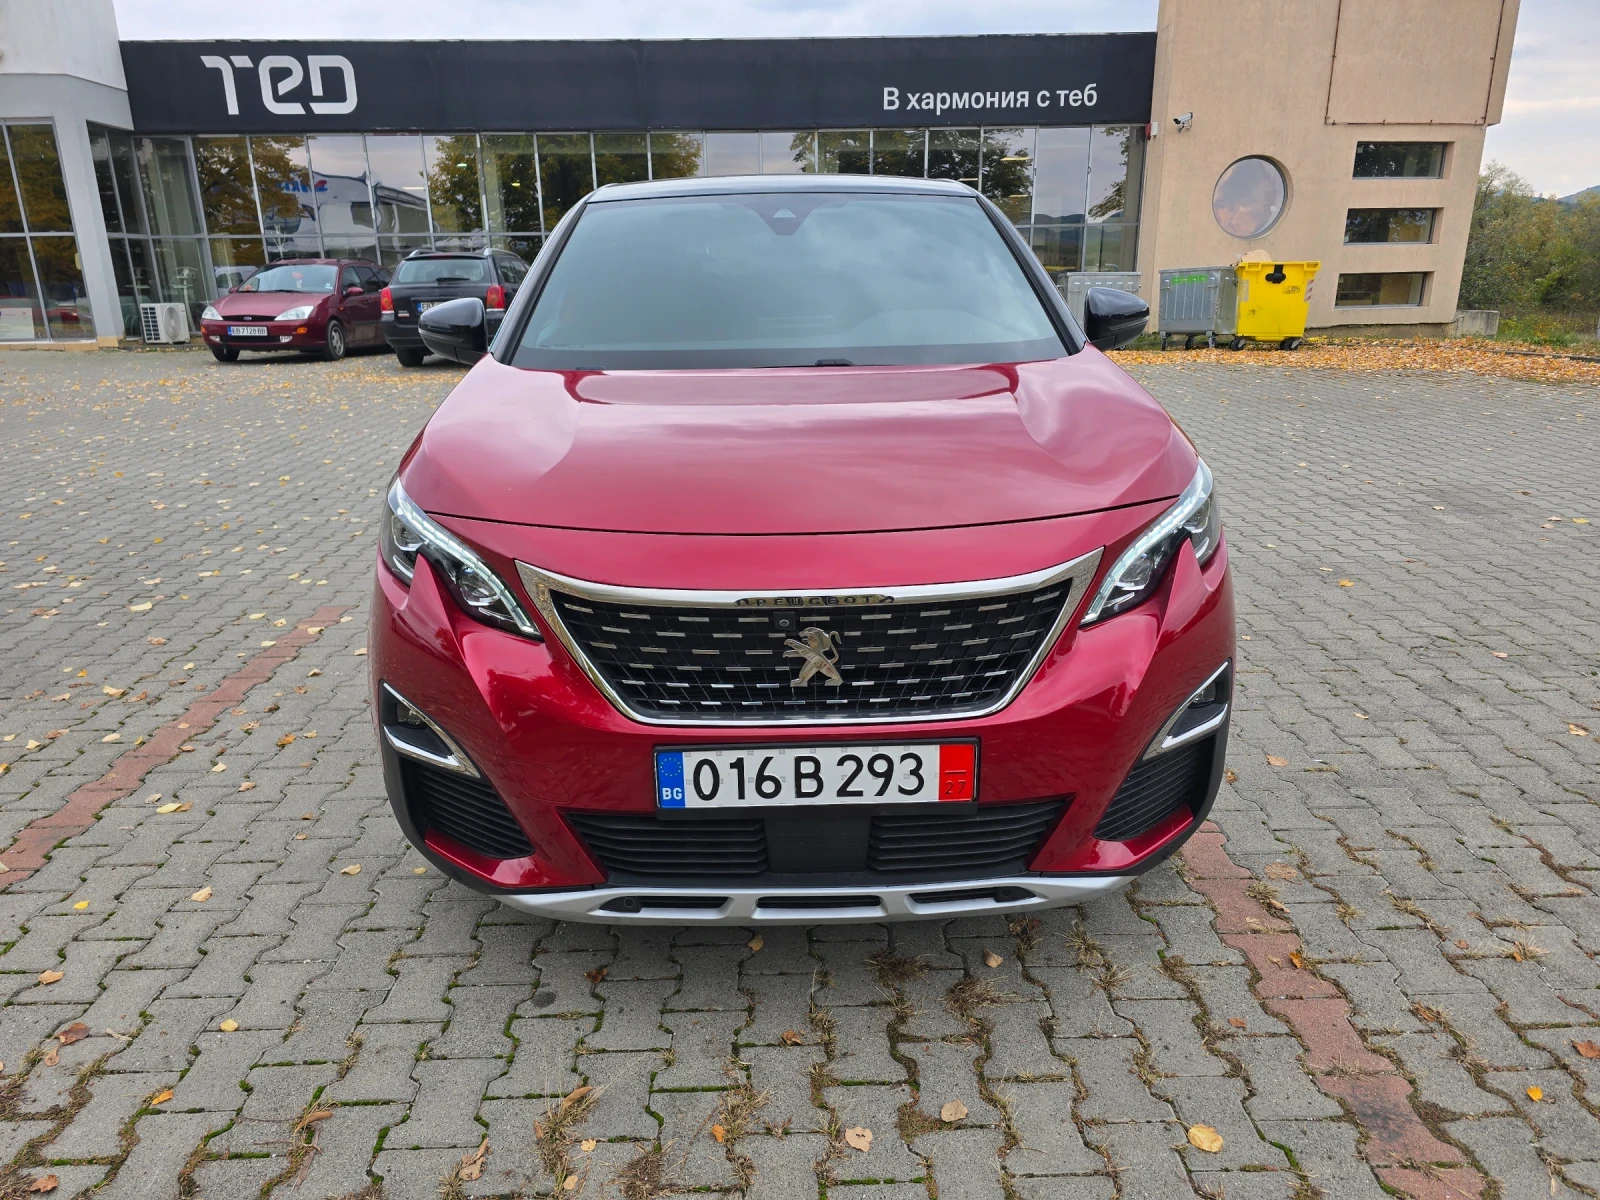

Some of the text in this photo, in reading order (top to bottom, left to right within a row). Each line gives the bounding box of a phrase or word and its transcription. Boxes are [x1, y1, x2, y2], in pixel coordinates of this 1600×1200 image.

[883, 83, 1098, 116] В хармония с теб
[662, 787, 683, 800] BG
[945, 779, 966, 795] 27
